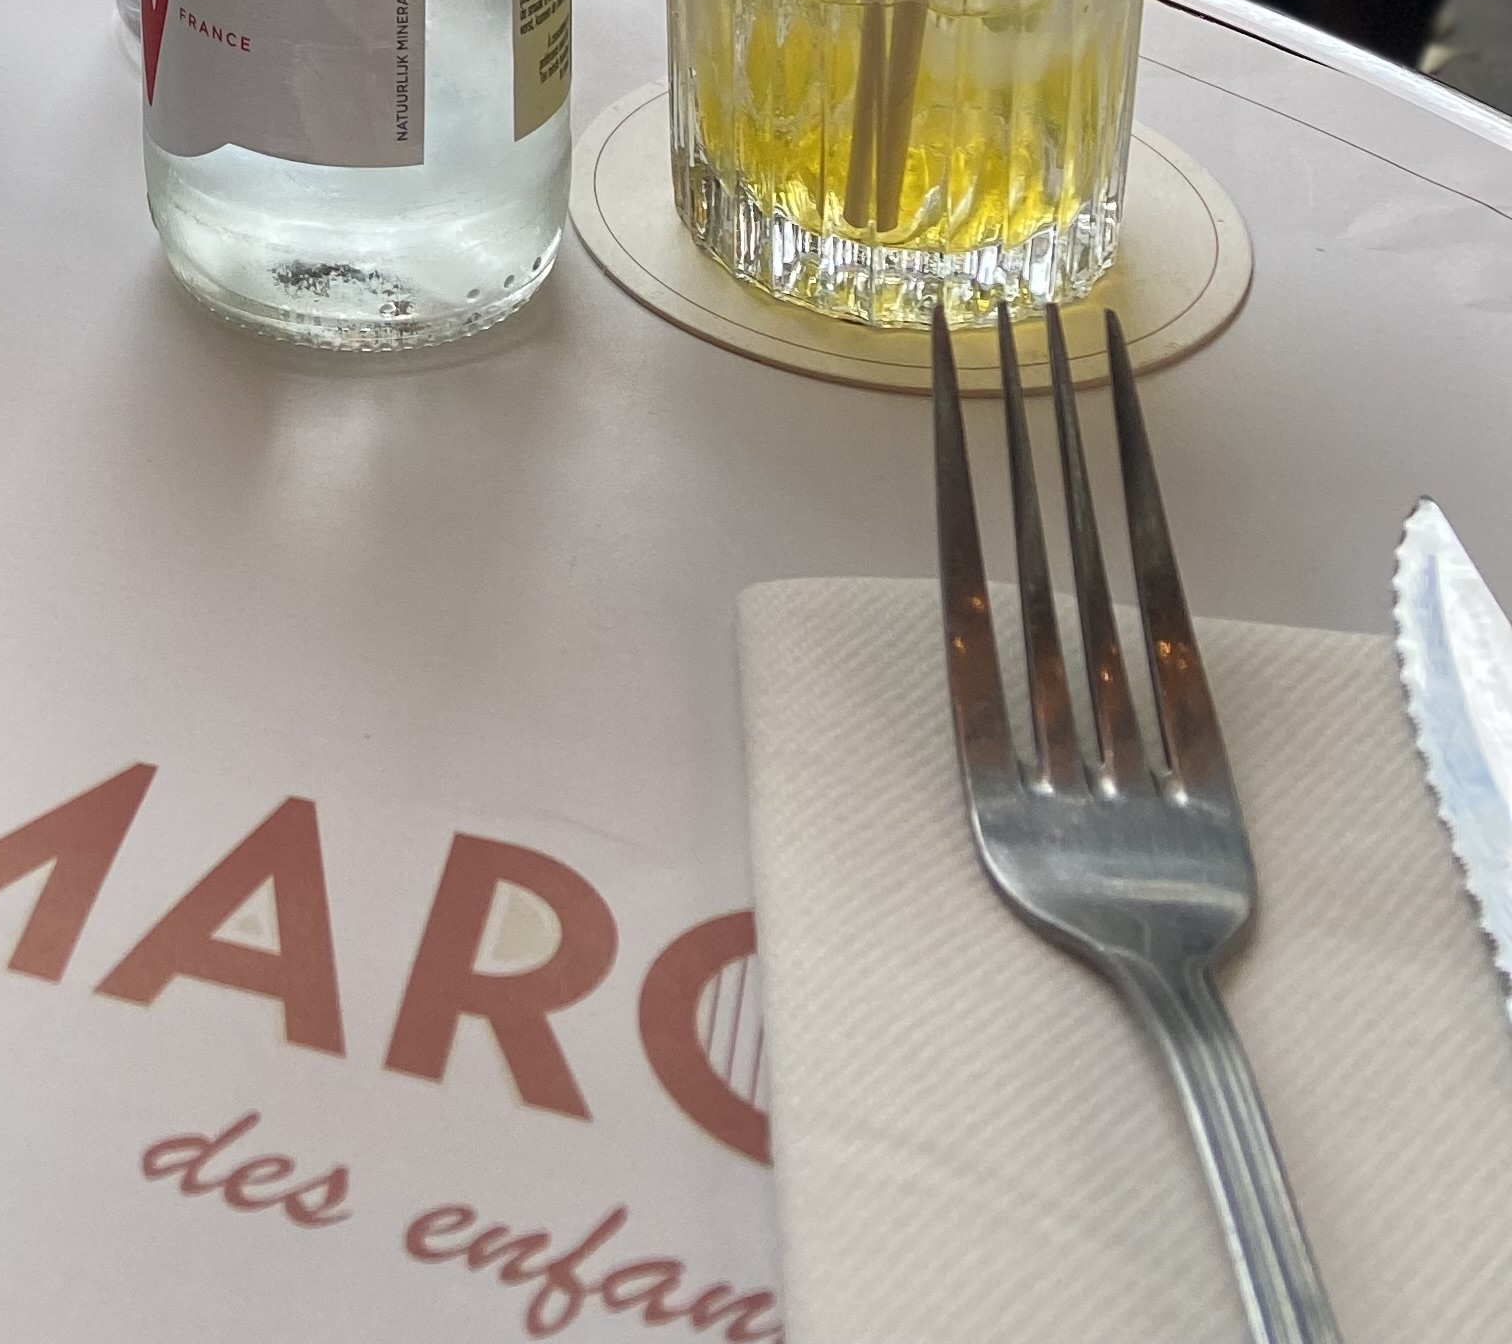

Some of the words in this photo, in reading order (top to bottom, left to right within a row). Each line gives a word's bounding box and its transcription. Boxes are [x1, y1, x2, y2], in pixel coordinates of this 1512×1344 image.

[178, 6, 252, 53] FRANCE
[396, 55, 410, 142] NATUURLIJK
[139, 1109, 352, 1229] des
